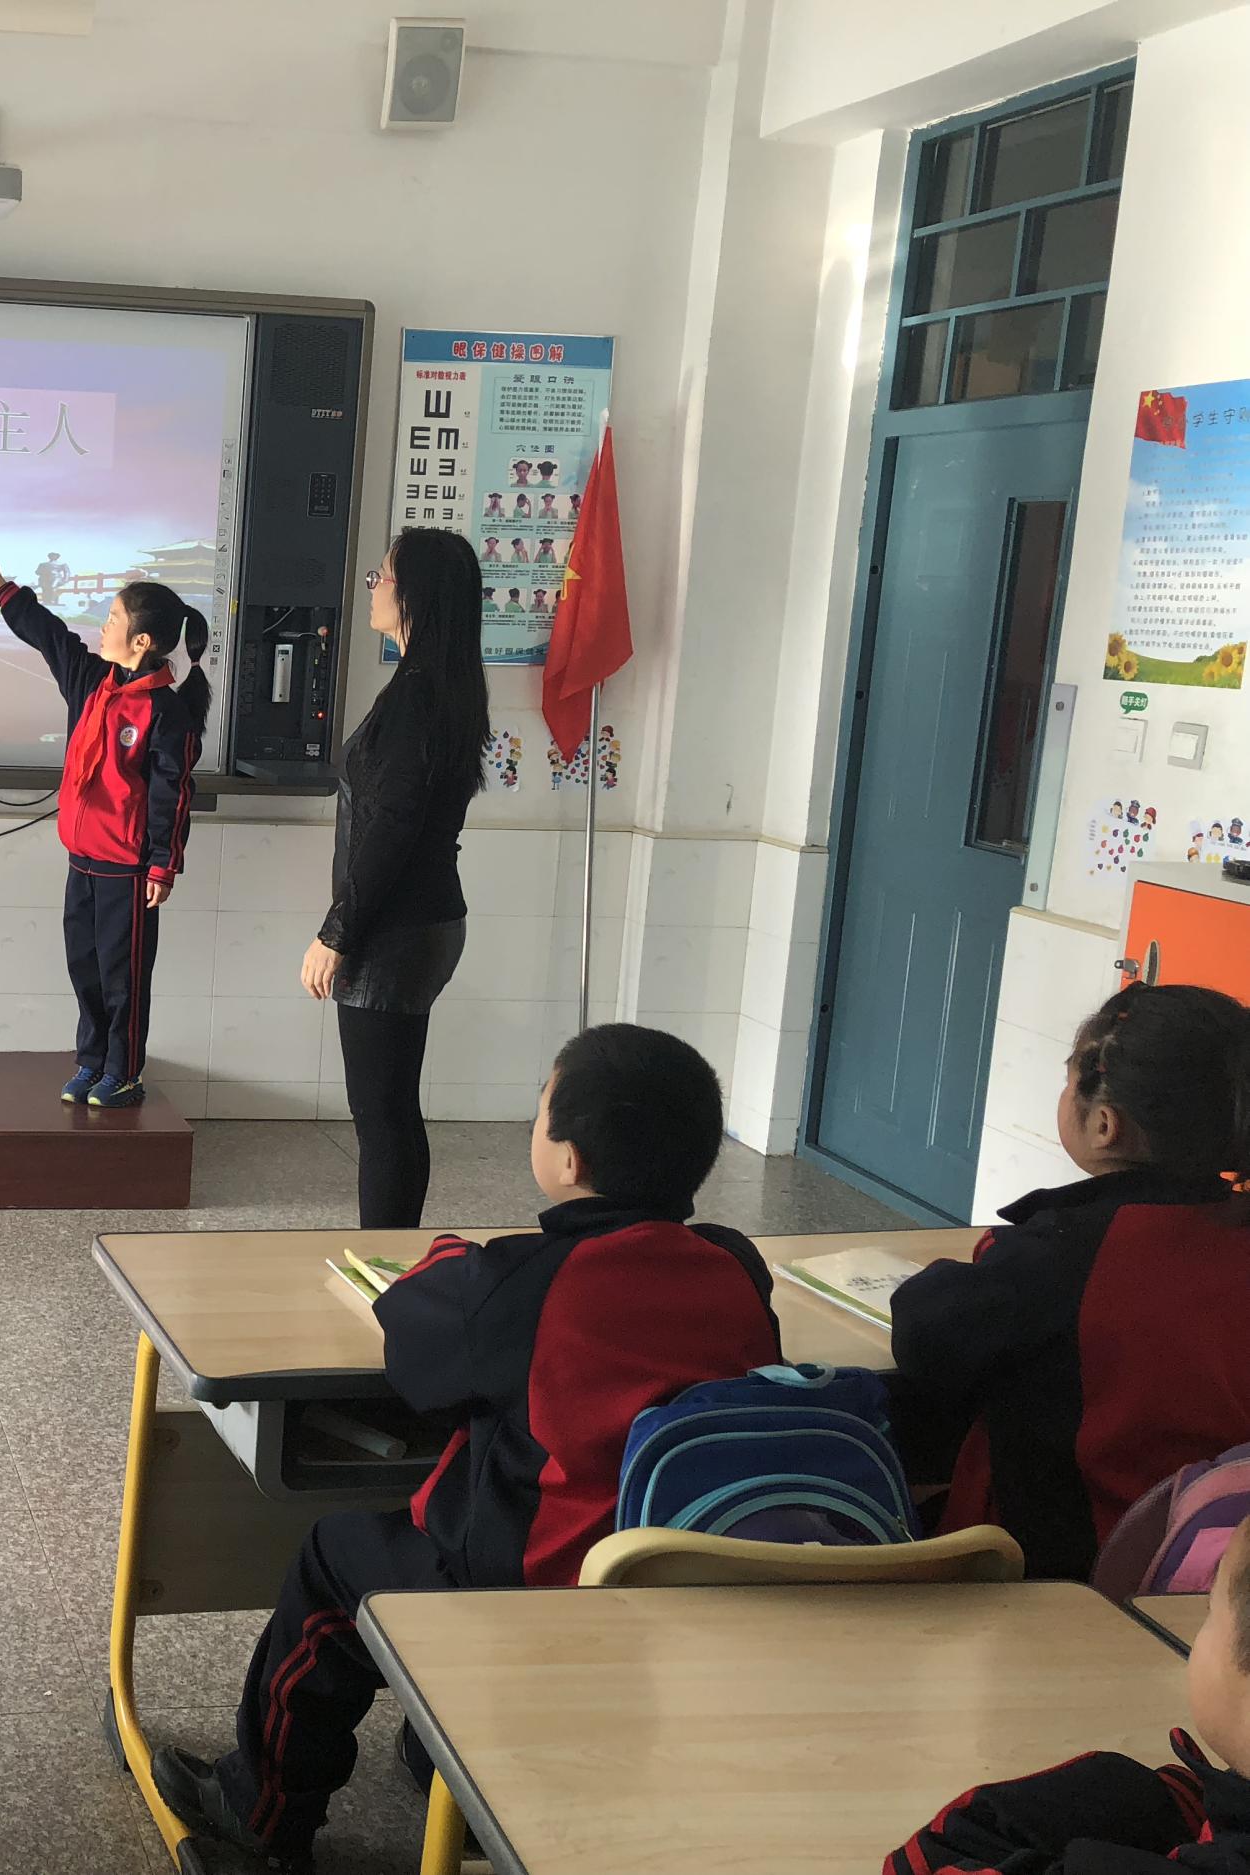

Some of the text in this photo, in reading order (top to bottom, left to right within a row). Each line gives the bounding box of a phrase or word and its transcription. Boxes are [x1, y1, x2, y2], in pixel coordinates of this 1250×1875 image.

[452, 341, 565, 362] 眼保健操图解
[416, 369, 467, 381] 标准对数视力表
